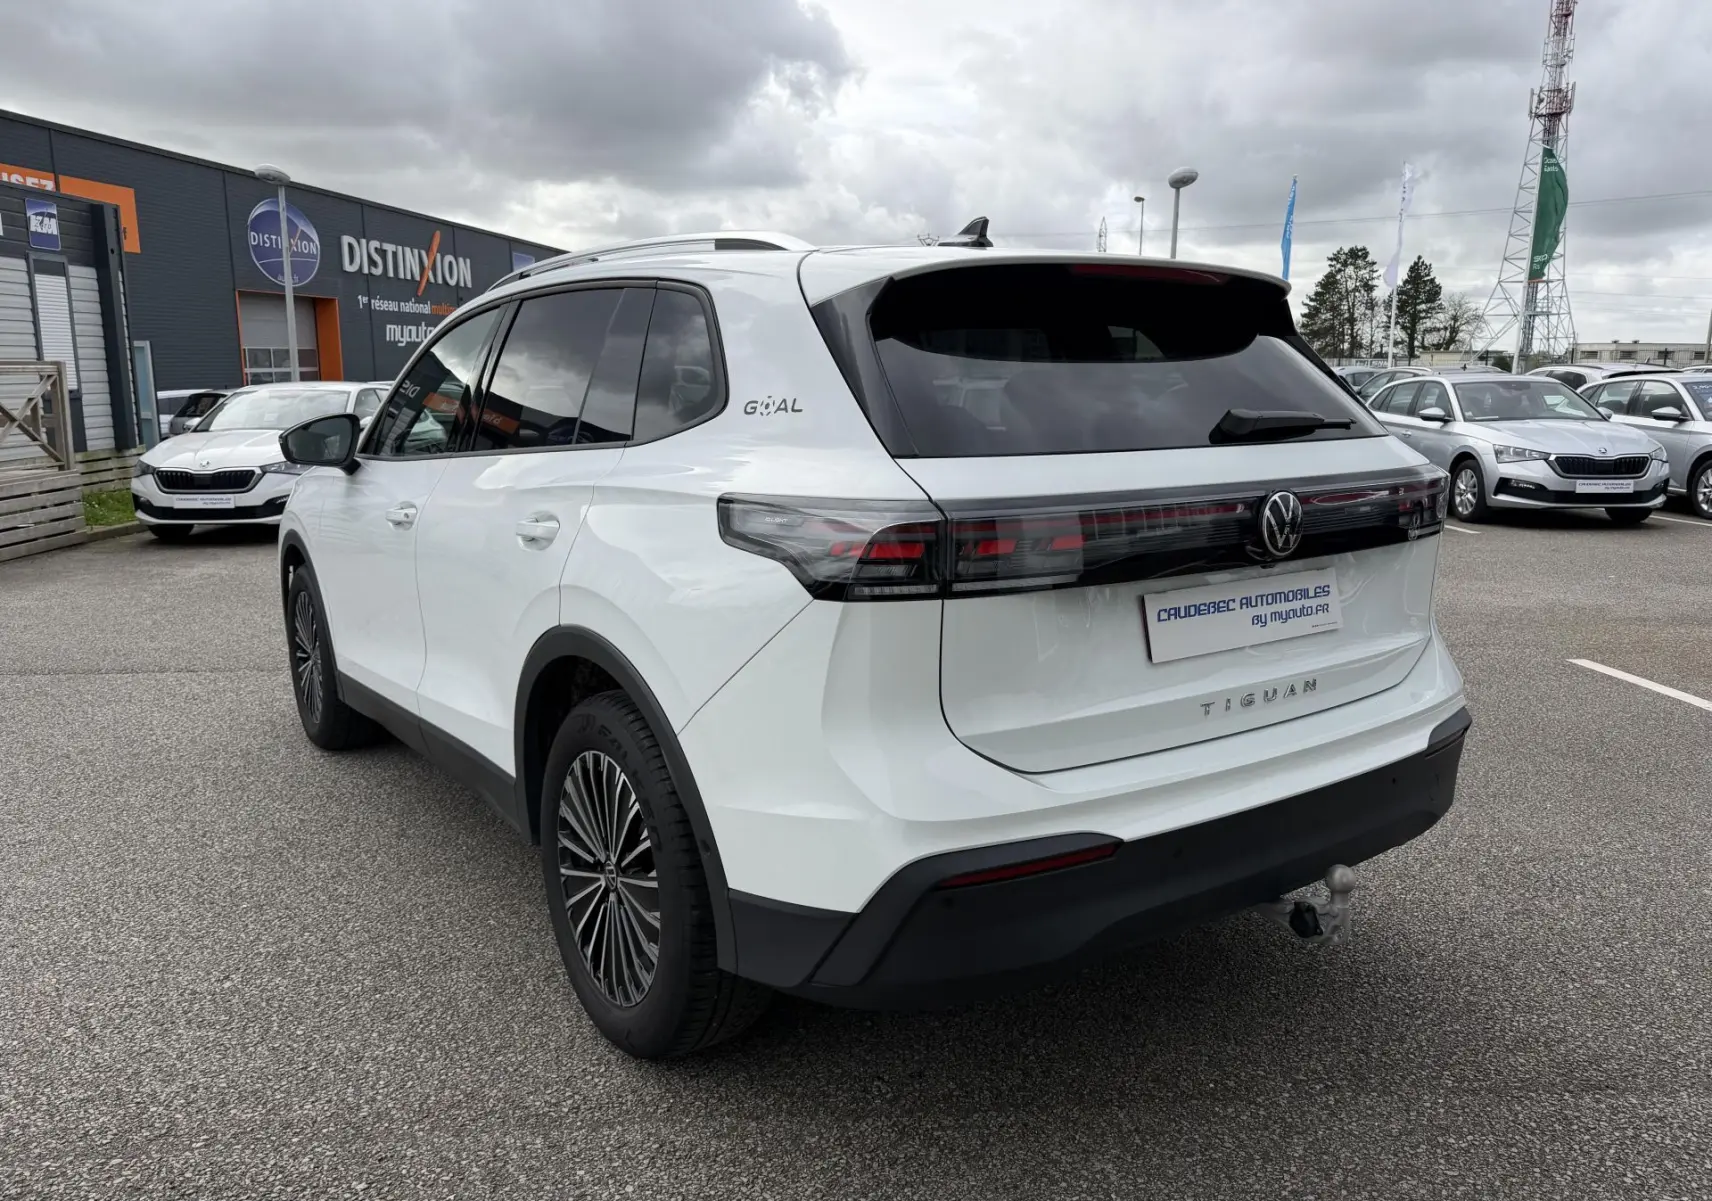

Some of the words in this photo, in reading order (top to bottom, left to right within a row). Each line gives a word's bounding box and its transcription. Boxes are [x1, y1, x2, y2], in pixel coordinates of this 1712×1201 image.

[250, 229, 317, 256] DISTIXION
[340, 230, 473, 296] DISTINXION
[357, 294, 369, 309] 1er
[371, 295, 399, 312] réseau
[399, 297, 431, 315] national
[1157, 598, 1236, 623] CAUDEBEC
[1239, 584, 1331, 611] AUTOMOBILES
[1200, 678, 1318, 717] TIGUAN
